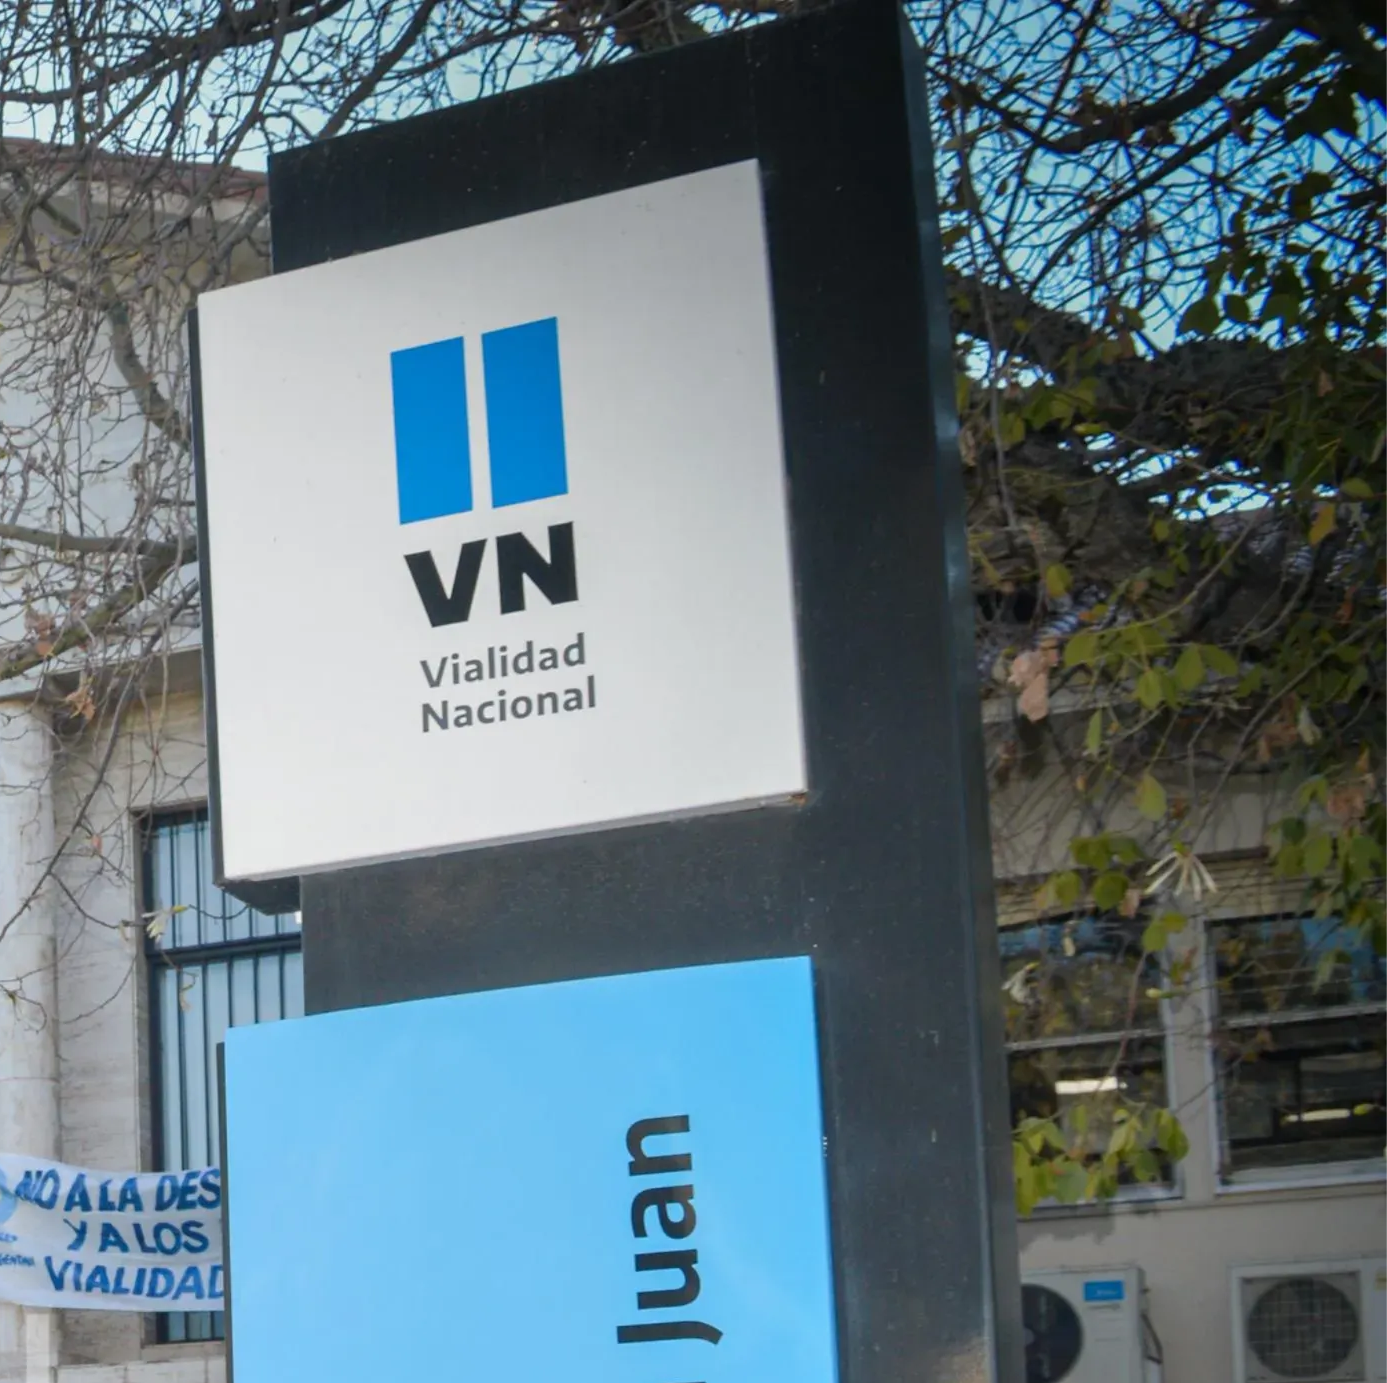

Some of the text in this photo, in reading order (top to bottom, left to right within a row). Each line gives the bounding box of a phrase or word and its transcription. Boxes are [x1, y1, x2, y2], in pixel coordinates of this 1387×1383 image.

[402, 520, 579, 628] VN
[420, 631, 587, 689] Vialidad
[421, 674, 597, 733] Nacional
[14, 1168, 61, 1210] NO
[63, 1173, 93, 1212] A
[97, 1176, 145, 1212] LA
[62, 1218, 210, 1256] Y A LOS
[615, 1112, 725, 1345] Juan
